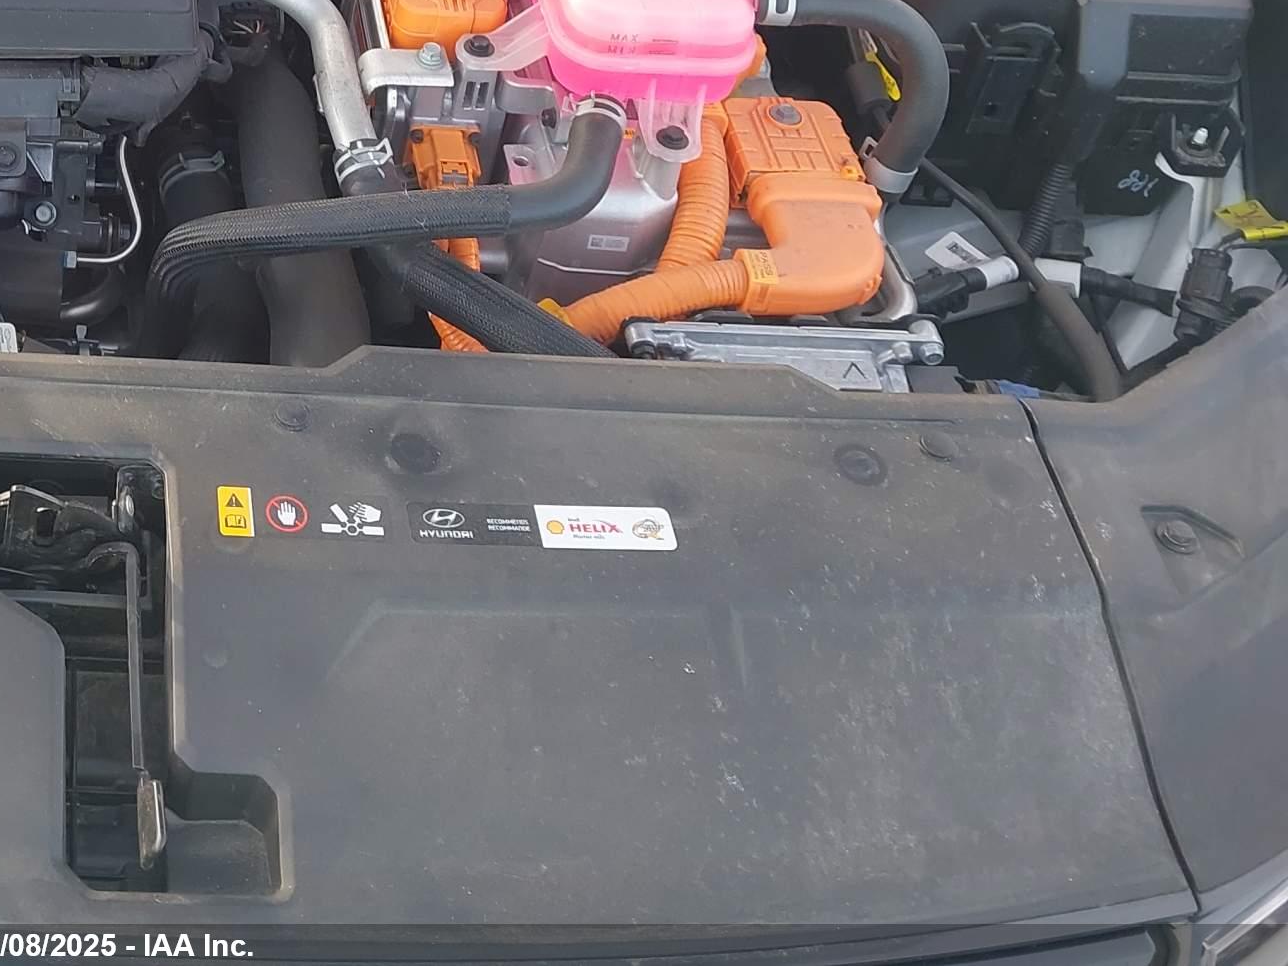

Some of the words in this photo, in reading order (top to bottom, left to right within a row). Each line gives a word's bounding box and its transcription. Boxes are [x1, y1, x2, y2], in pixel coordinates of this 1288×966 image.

[610, 33, 639, 43] MAX
[569, 523, 621, 534] HELIX
[419, 529, 474, 539] HYUNDAI
